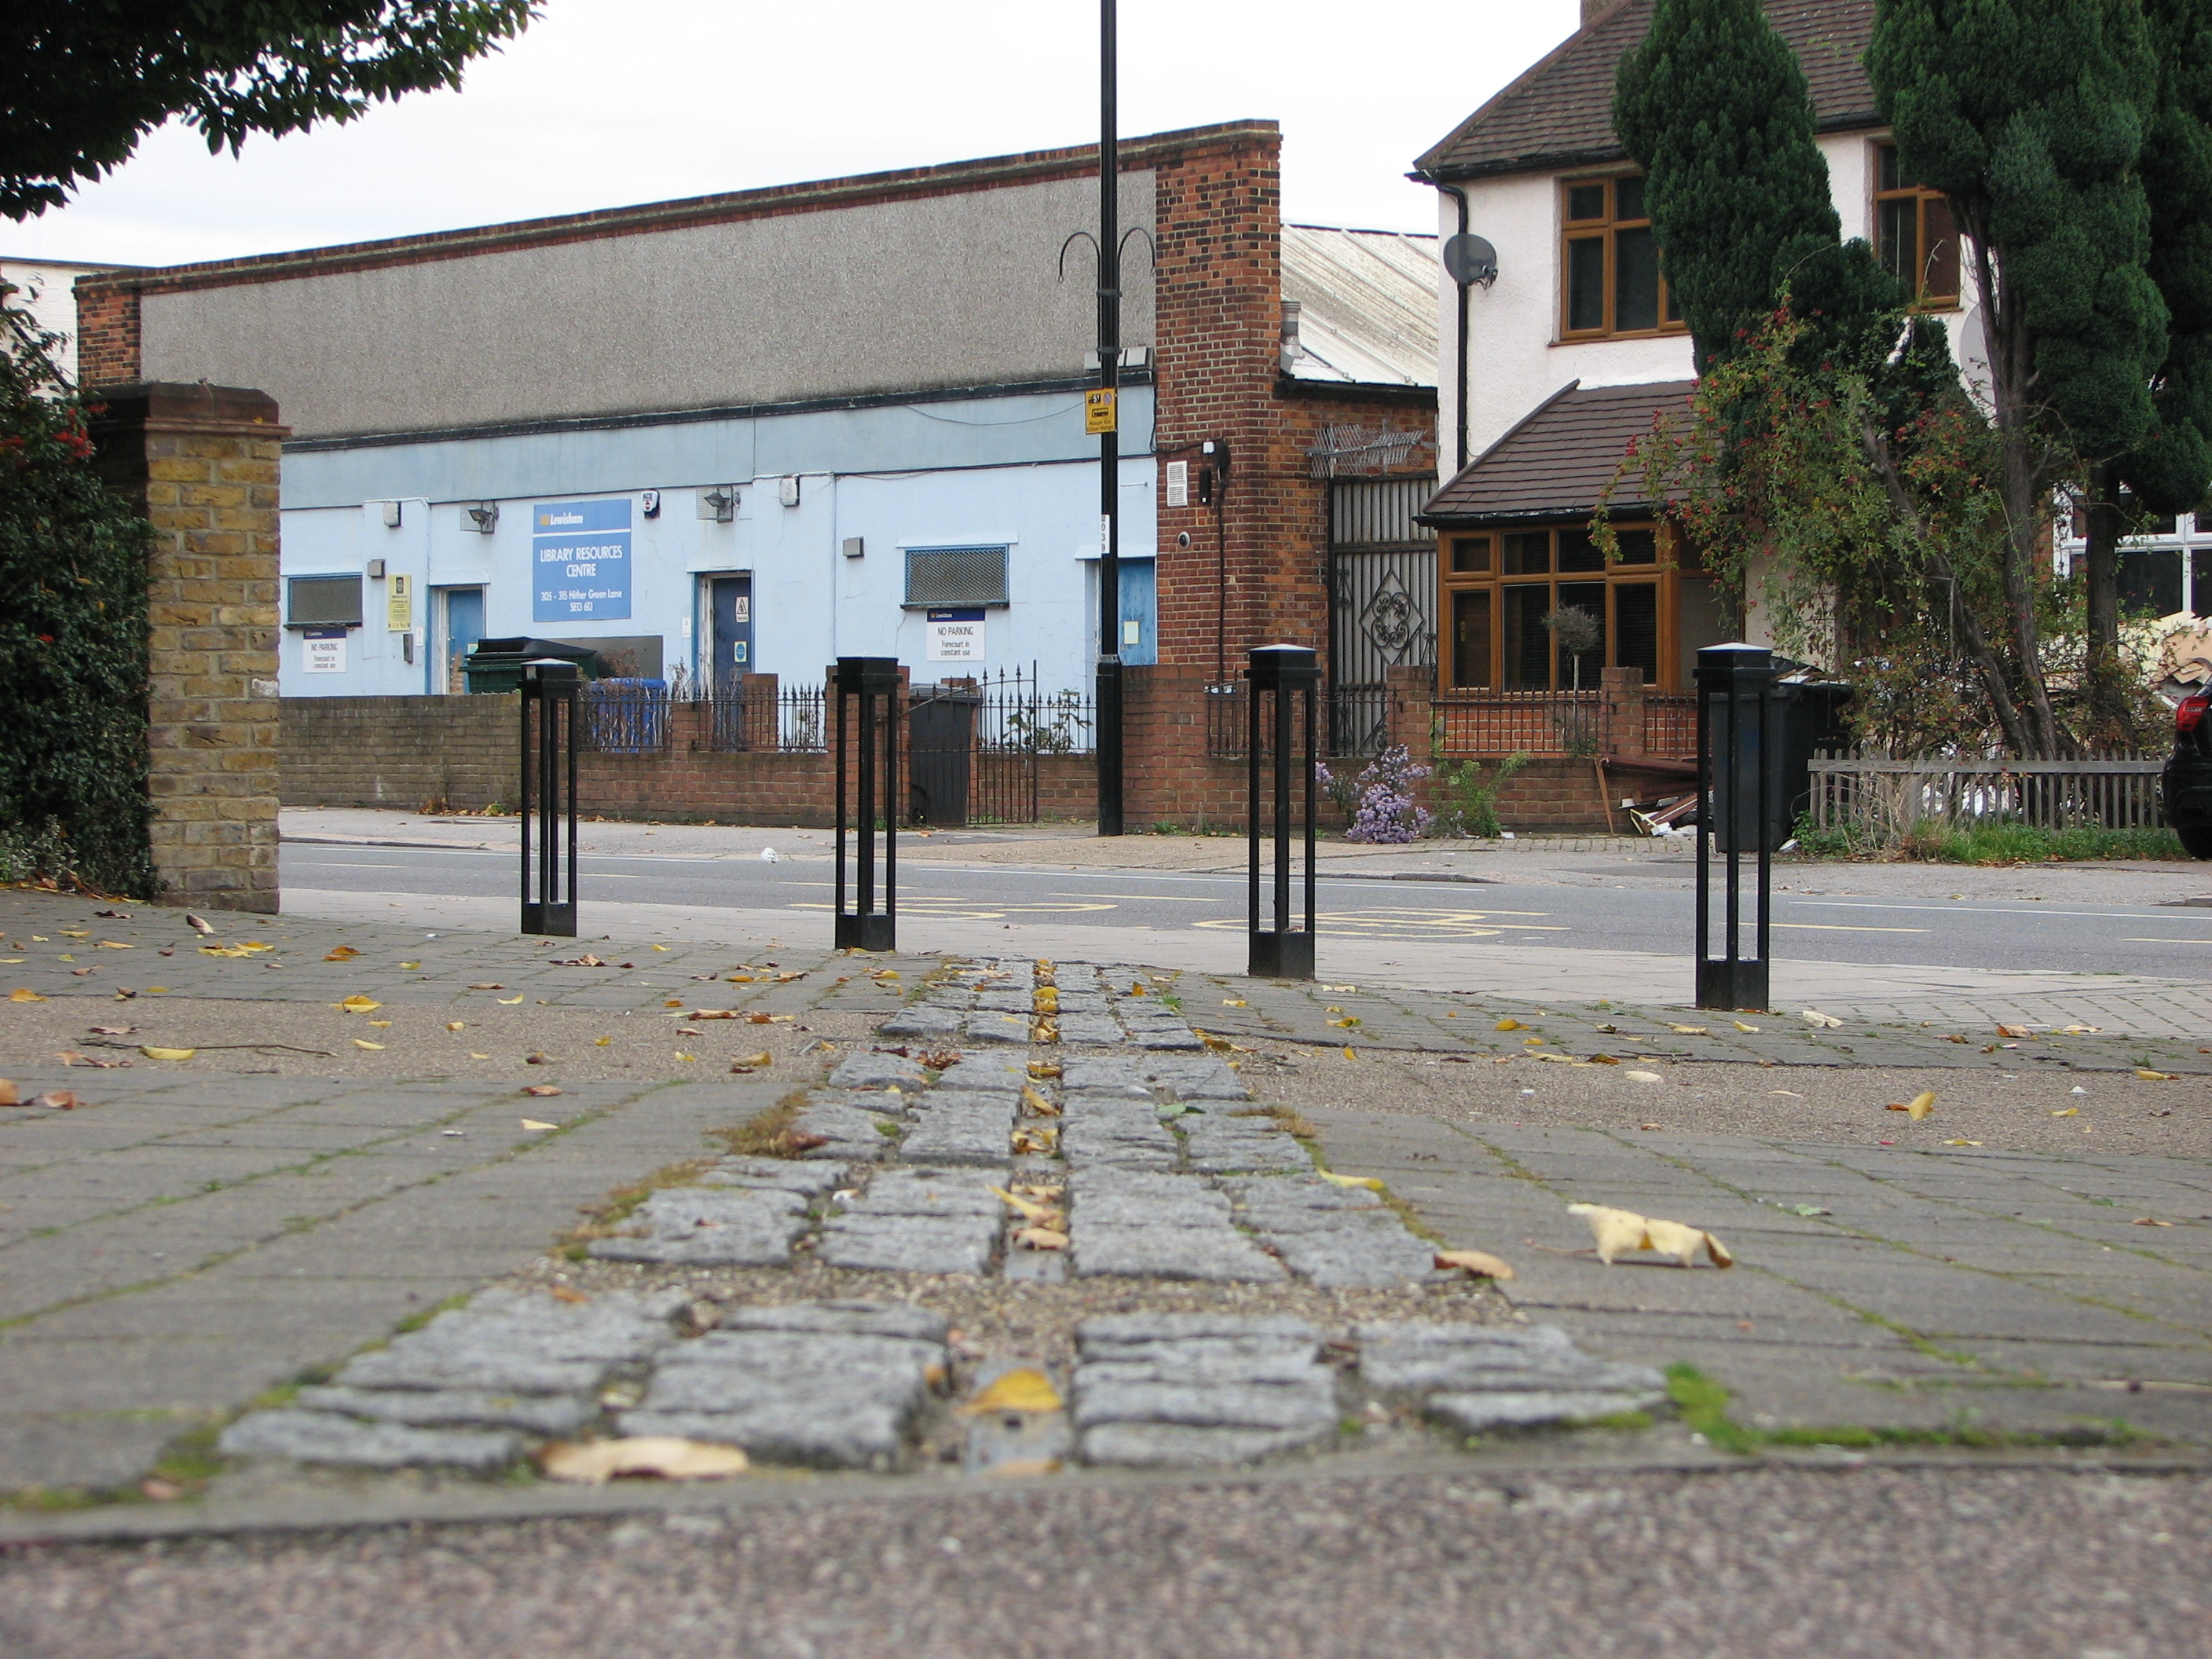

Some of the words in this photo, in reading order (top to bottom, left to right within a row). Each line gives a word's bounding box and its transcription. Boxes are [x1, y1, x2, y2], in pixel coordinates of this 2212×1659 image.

[551, 512, 583, 525] Lewisham
[540, 548, 573, 562] LIBRARY
[577, 545, 622, 560] RESOURCES
[566, 563, 596, 577] CENTRE
[540, 591, 552, 602] 305
[558, 590, 567, 600] 315
[569, 589, 587, 600] Hither
[588, 589, 606, 599] Green
[607, 588, 622, 599] Lane
[937, 627, 947, 635] NO
[948, 626, 973, 635] PARKING
